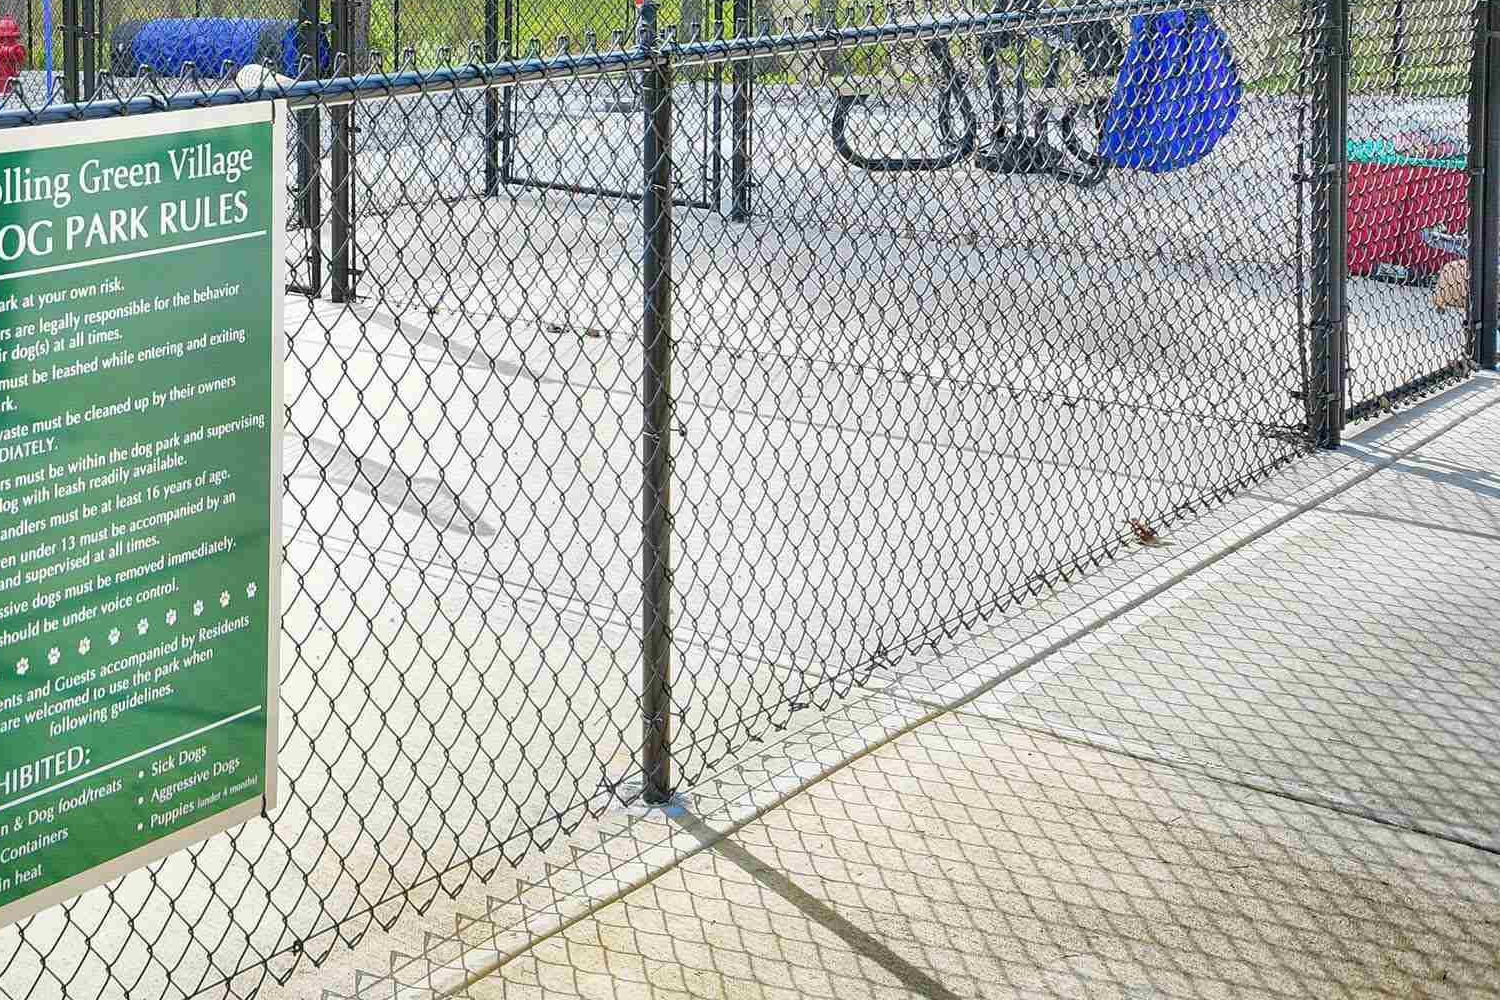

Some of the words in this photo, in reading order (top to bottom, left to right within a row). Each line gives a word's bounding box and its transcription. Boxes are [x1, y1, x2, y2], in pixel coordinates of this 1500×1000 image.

[79, 159, 161, 194] Green
[167, 143, 253, 183] Village
[66, 205, 149, 250] PARK
[160, 190, 248, 235] RULES
[15, 324, 36, 338] are
[39, 311, 80, 335] legally
[84, 298, 151, 325] responsible
[154, 296, 170, 311] for
[172, 292, 190, 307] the
[193, 283, 240, 303] behavior
[21, 294, 34, 308] at
[38, 290, 67, 309] your
[70, 285, 97, 299] own
[100, 276, 125, 294] risk.
[11, 339, 50, 361] dog(s)
[53, 338, 65, 352] at
[69, 331, 84, 349] all
[88, 328, 123, 345] times.
[32, 369, 48, 384] be
[52, 357, 99, 380] leashed
[101, 350, 135, 369] while
[137, 342, 184, 362] entering
[186, 333, 207, 351] and
[209, 328, 246, 346] exiting
[32, 415, 62, 433] must
[65, 410, 81, 426] be
[84, 396, 131, 422] cleaned
[134, 397, 149, 413] up
[152, 391, 167, 408] by
[169, 383, 196, 401] their
[197, 375, 236, 394] owners
[15, 468, 45, 488] must
[48, 463, 64, 479] be
[67, 453, 106, 473] within
[109, 447, 128, 464] the
[130, 442, 153, 458] dog
[155, 431, 181, 455] park
[183, 425, 204, 444] and
[207, 414, 265, 439] supervising
[22, 487, 50, 507] with
[54, 477, 86, 499] leash
[89, 466, 130, 489] readily
[133, 452, 187, 478] available.
[50, 508, 79, 528] must
[82, 503, 98, 519] be
[101, 499, 112, 514] at
[115, 491, 142, 510] least
[146, 485, 160, 501] 16
[163, 479, 193, 500] years
[194, 470, 207, 487] of
[209, 469, 231, 486] age.
[20, 542, 57, 564] under
[61, 535, 76, 551] 13
[79, 527, 108, 547] must
[111, 522, 126, 537] be
[129, 497, 204, 532] accompanied
[206, 495, 220, 512] by
[222, 492, 236, 505] an
[25, 550, 90, 584] supervised
[93, 549, 105, 563] at
[108, 540, 123, 559] all
[126, 535, 160, 553] times.
[32, 590, 62, 609] dogs
[64, 579, 94, 600] must
[96, 574, 112, 590] be
[115, 554, 165, 583] removed
[167, 535, 236, 567] immediately.
[43, 618, 59, 633] be
[62, 605, 98, 627] under
[100, 595, 133, 614] voice
[135, 577, 179, 603] control.
[26, 679, 51, 702] and
[54, 669, 96, 692] Guests
[100, 636, 178, 677] accompanied
[181, 634, 196, 650] by
[198, 615, 250, 642] Residents
[0, 717, 21, 733] are
[24, 687, 90, 724] welcomed
[93, 687, 106, 701] to
[109, 679, 129, 694] use
[132, 669, 151, 687] the
[154, 657, 180, 682] park
[183, 648, 213, 668] when
[49, 707, 108, 737] following
[111, 684, 174, 719] guidelines.
[150, 770, 210, 803] Aggressive
[213, 758, 240, 777] Dogs
[151, 755, 175, 777] Sick
[178, 745, 207, 766] Dogs
[13, 816, 23, 832] &
[28, 806, 54, 825] Dog
[58, 779, 122, 814] food/treats
[150, 801, 195, 828] Puppies
[0, 827, 69, 864] Containers
[15, 863, 42, 885] heat
